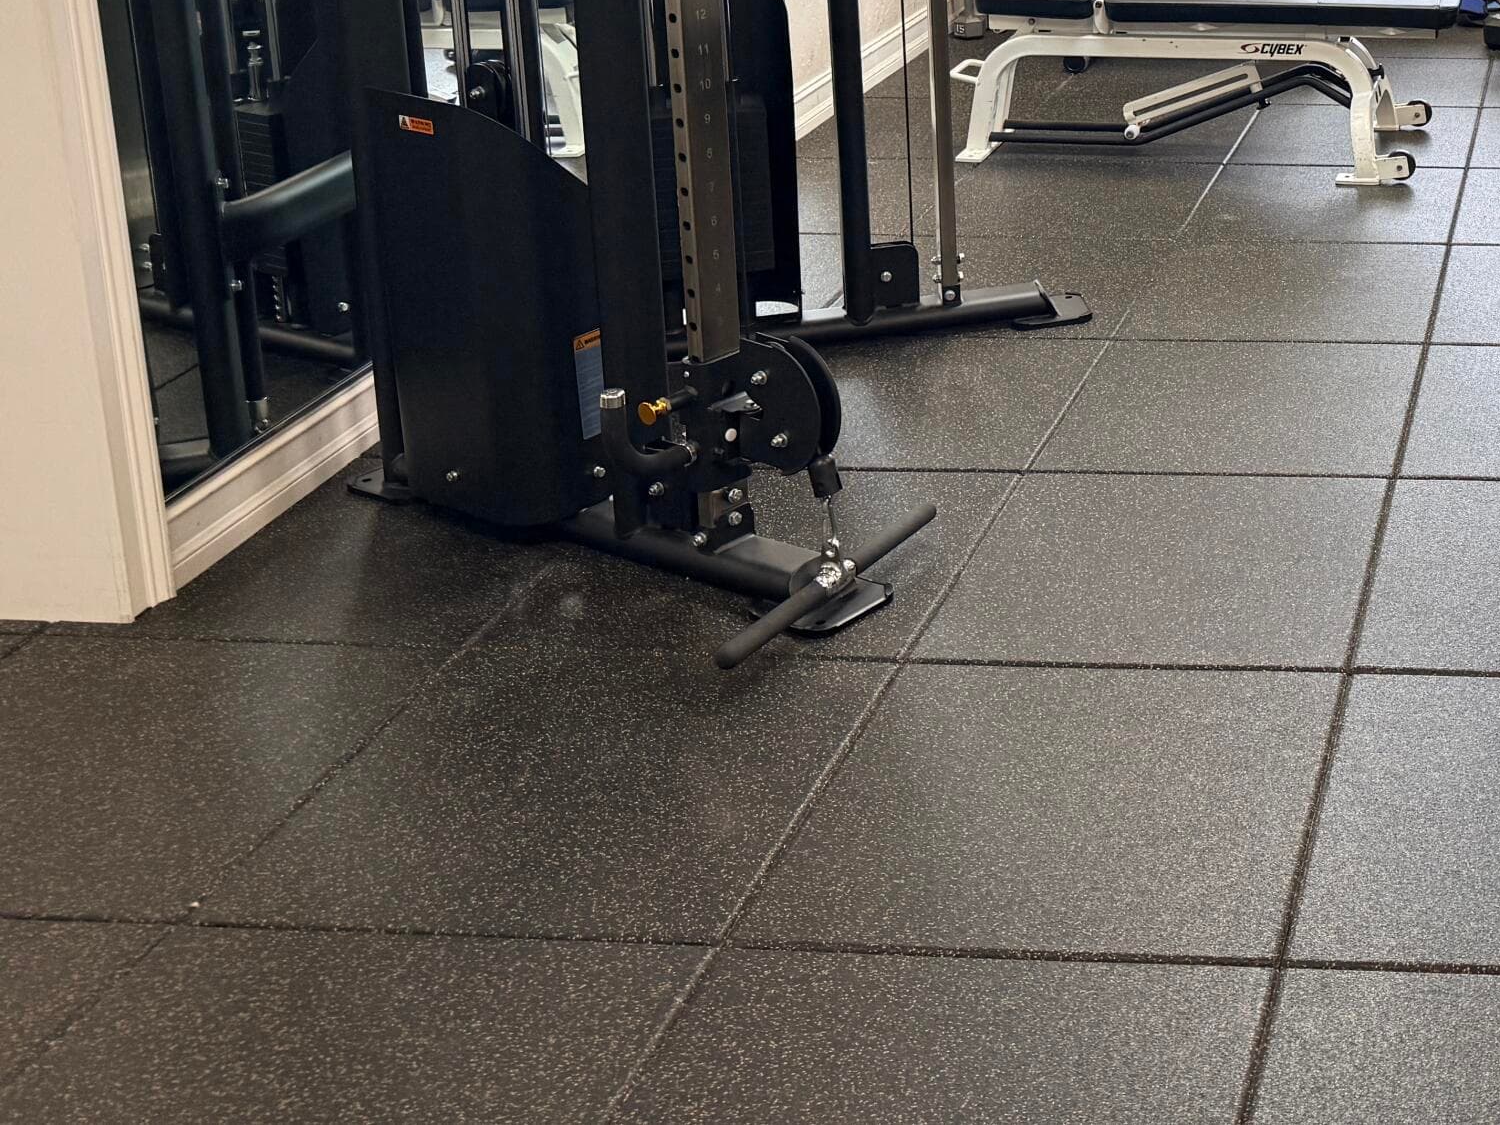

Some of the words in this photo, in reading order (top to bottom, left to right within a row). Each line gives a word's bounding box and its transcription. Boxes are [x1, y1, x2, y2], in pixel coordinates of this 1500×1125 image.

[695, 9, 707, 20] 12
[698, 44, 710, 55] 11
[1260, 43, 1304, 57] CYBEX
[700, 78, 711, 90] 10
[704, 114, 711, 125] 9
